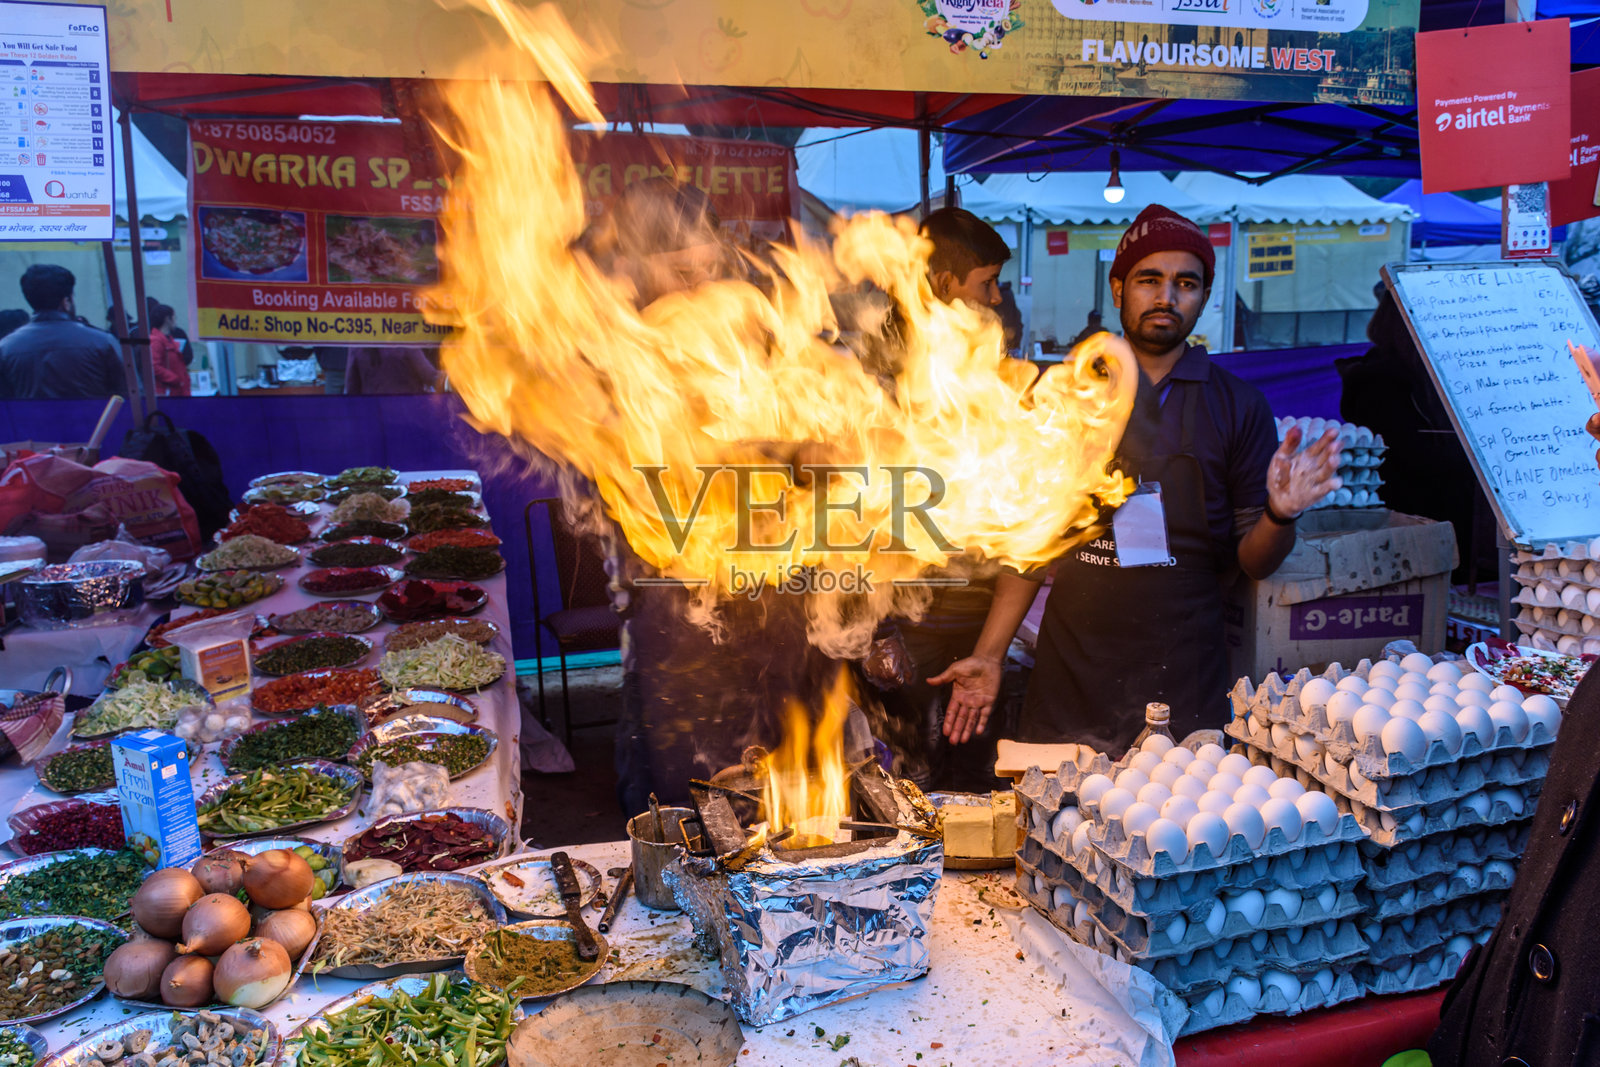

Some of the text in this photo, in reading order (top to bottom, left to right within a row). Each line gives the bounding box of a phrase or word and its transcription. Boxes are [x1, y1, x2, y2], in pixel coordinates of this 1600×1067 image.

[1082, 39, 1335, 71] FLAVOURSOME WEST
[1435, 91, 1518, 107] Payments Powered By
[1455, 106, 1506, 130] airtel
[1508, 114, 1531, 124] Bank
[193, 141, 356, 190] DWARKA
[252, 289, 318, 311] Booking
[323, 291, 397, 309] Available
[264, 316, 303, 336] Shop
[382, 318, 418, 334] Near
[1080, 551, 1111, 567] SERVE
[1304, 605, 1411, 631] Parle-G
[124, 757, 146, 773] Amul
